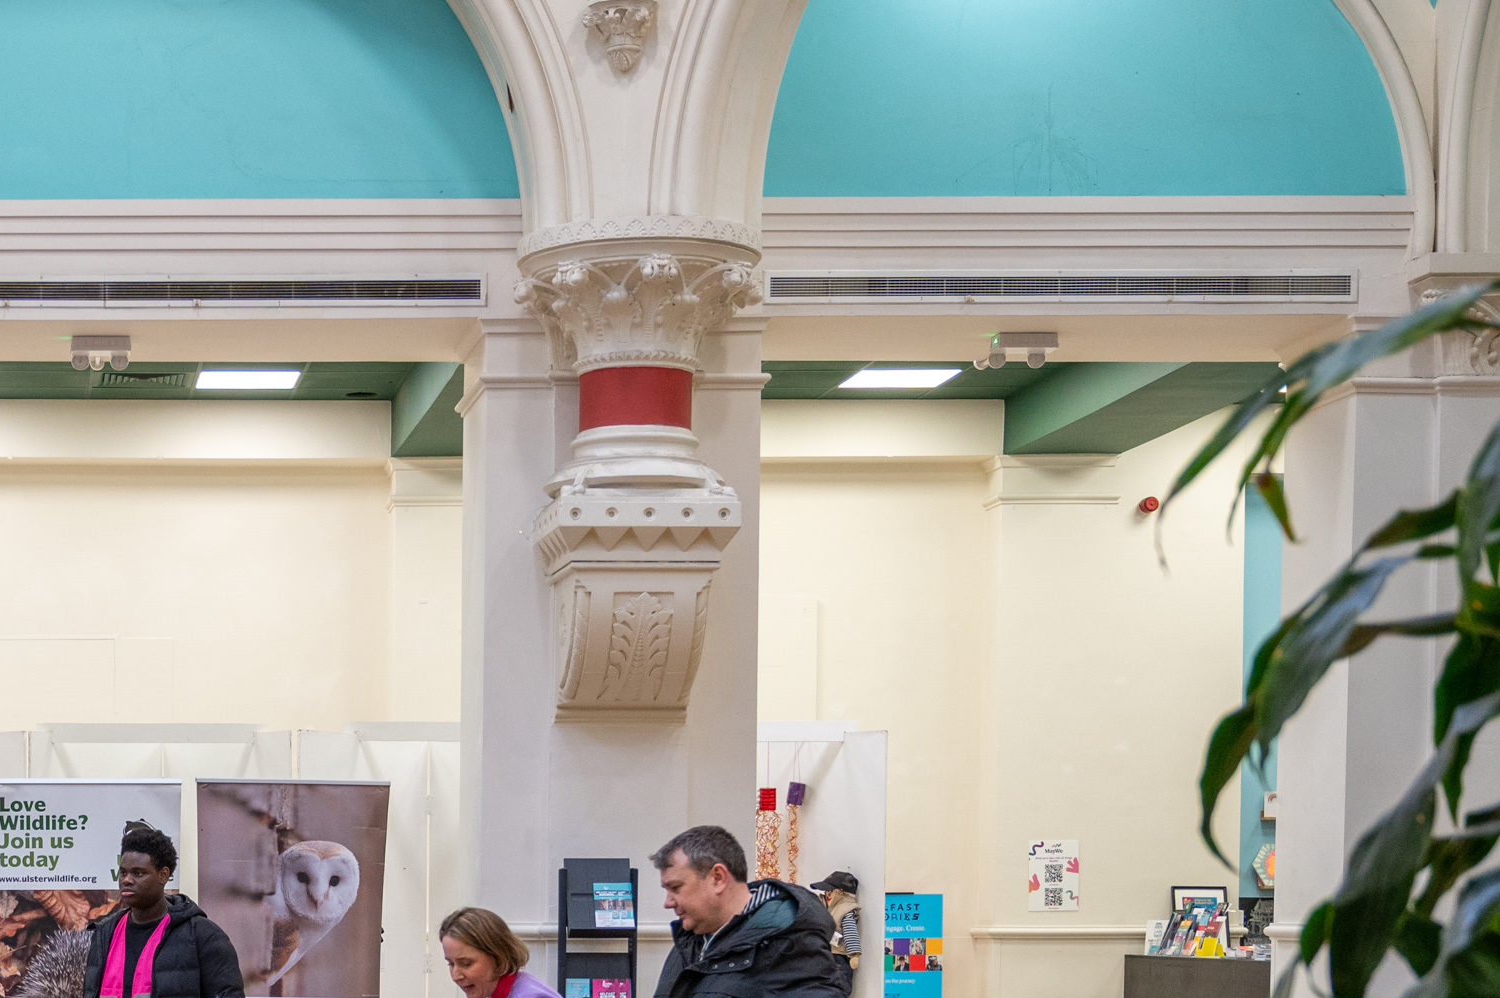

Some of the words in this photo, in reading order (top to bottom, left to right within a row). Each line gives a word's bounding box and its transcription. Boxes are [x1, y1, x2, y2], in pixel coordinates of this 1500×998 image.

[0, 797, 46, 812] Love
[0, 814, 88, 830] Wildlife?
[50, 836, 74, 849] us
